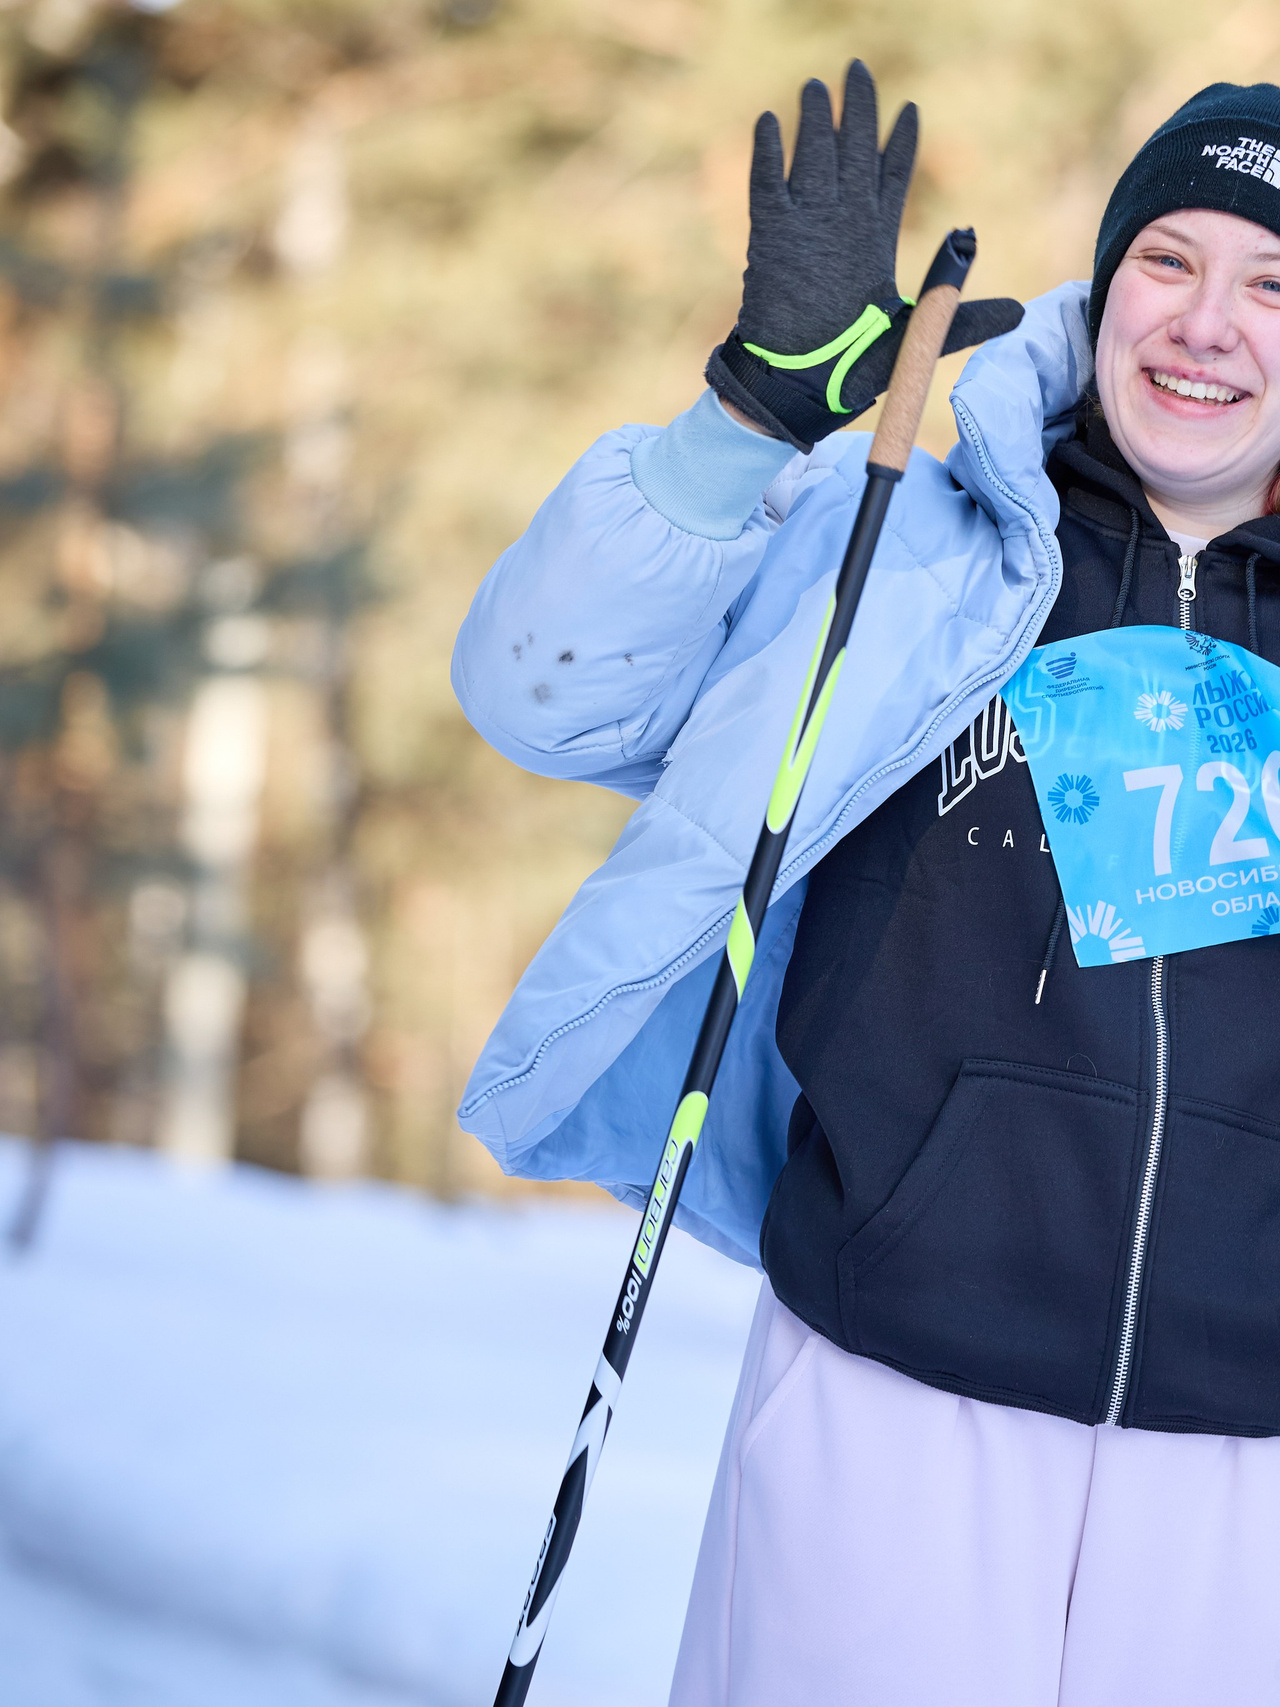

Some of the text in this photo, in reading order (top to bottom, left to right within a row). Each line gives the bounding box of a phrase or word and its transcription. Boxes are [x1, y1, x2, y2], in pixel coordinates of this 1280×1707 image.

[1201, 144, 1271, 169] NORTH
[1238, 136, 1276, 157] THE
[1215, 156, 1265, 179] FACE
[1046, 677, 1090, 689] ФЕДЕРАЛЬНАЯ
[1055, 681, 1087, 694] ДИРЕКЦИЯ
[1206, 728, 1258, 754] 2026
[616, 1269, 643, 1335] 100%
